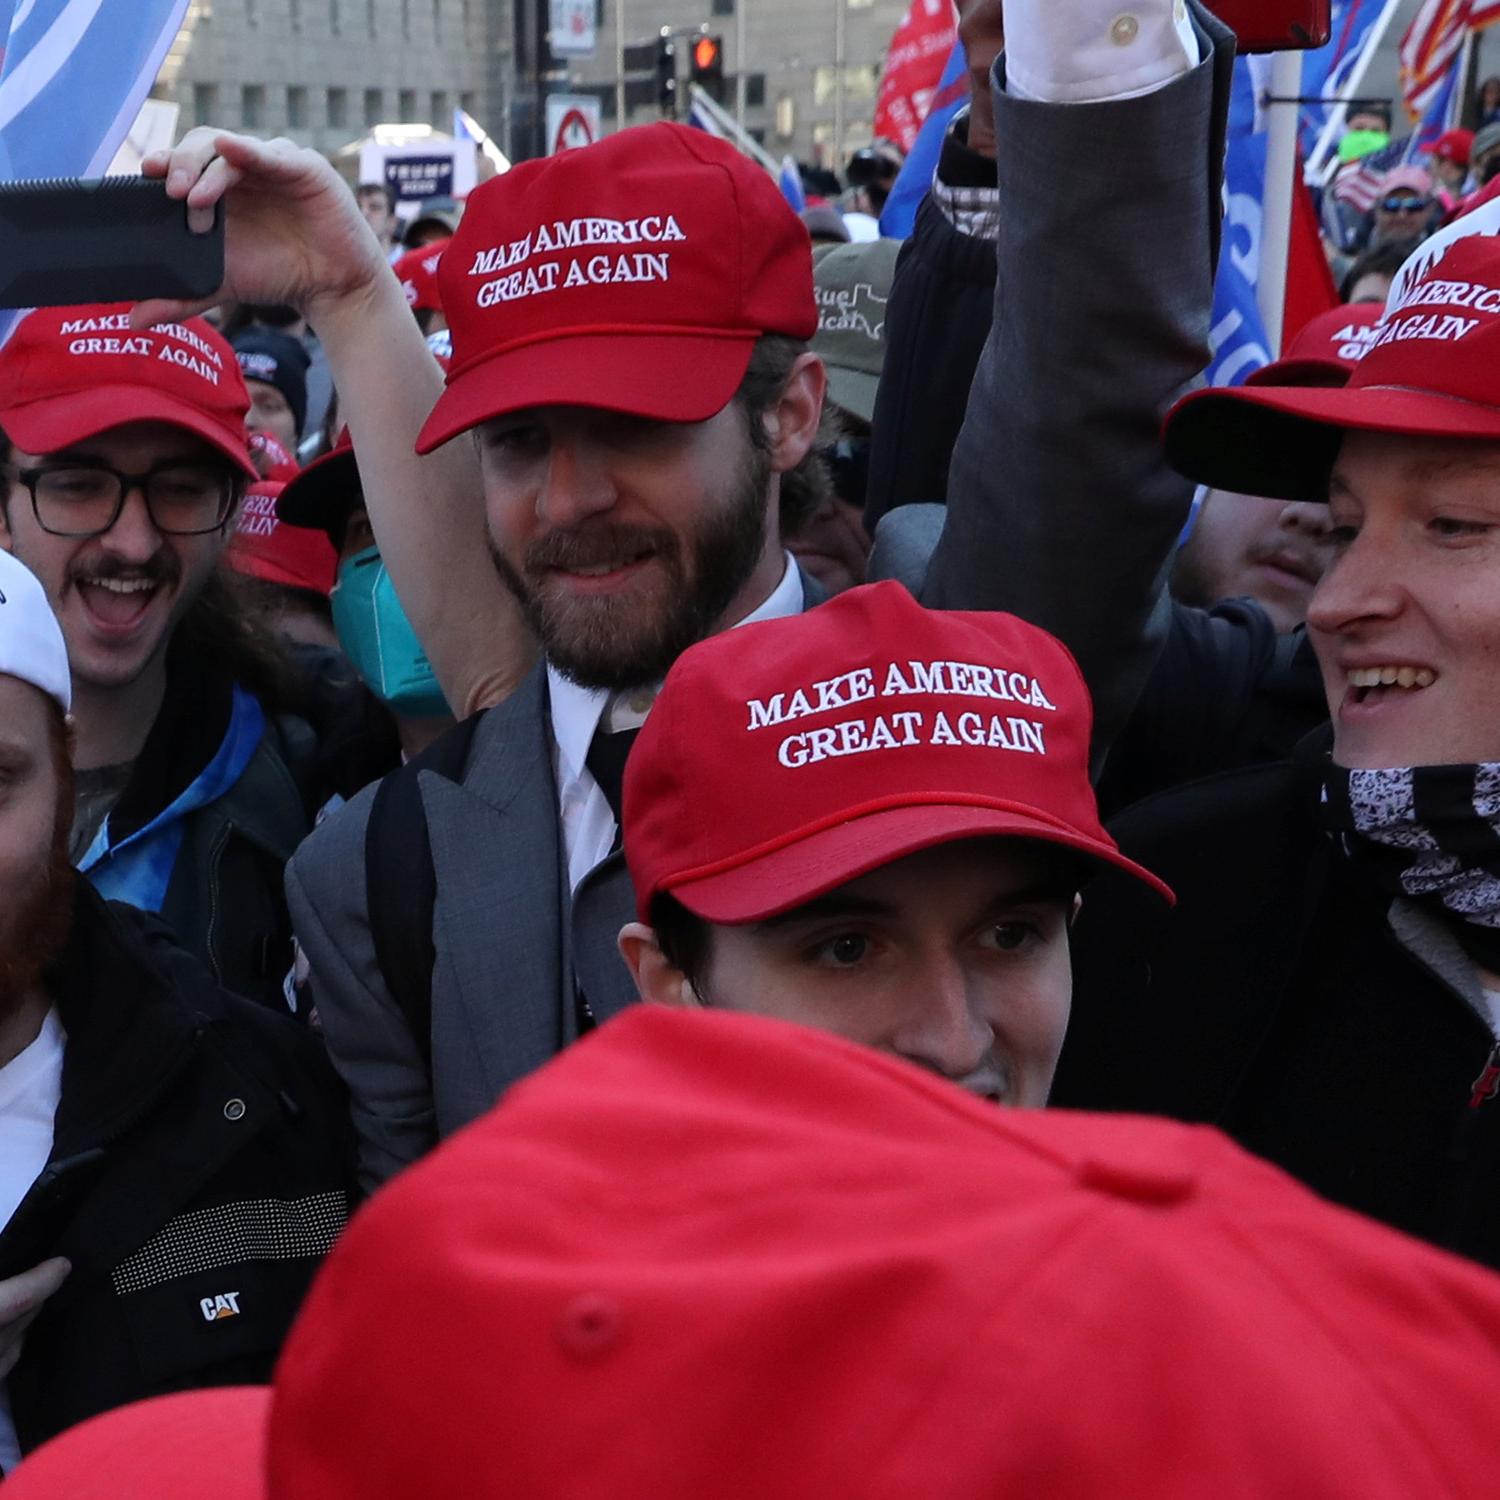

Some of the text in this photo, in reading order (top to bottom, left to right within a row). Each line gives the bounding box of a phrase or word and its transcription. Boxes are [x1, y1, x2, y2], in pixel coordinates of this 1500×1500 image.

[532, 215, 687, 253] AMERICA
[477, 262, 560, 308] GREAT
[563, 252, 670, 289] AGAIN
[1402, 280, 1500, 313] MERIC
[60, 314, 131, 336] MAKE
[149, 323, 224, 370] MERICA
[1377, 314, 1479, 346] AGAIN
[69, 338, 154, 356] GREAT
[157, 345, 219, 386] AGAIN
[746, 661, 1057, 730] MAKE AMERICA
[778, 711, 1046, 768] GREAT AGAIN
[200, 1292, 240, 1321] CAT
